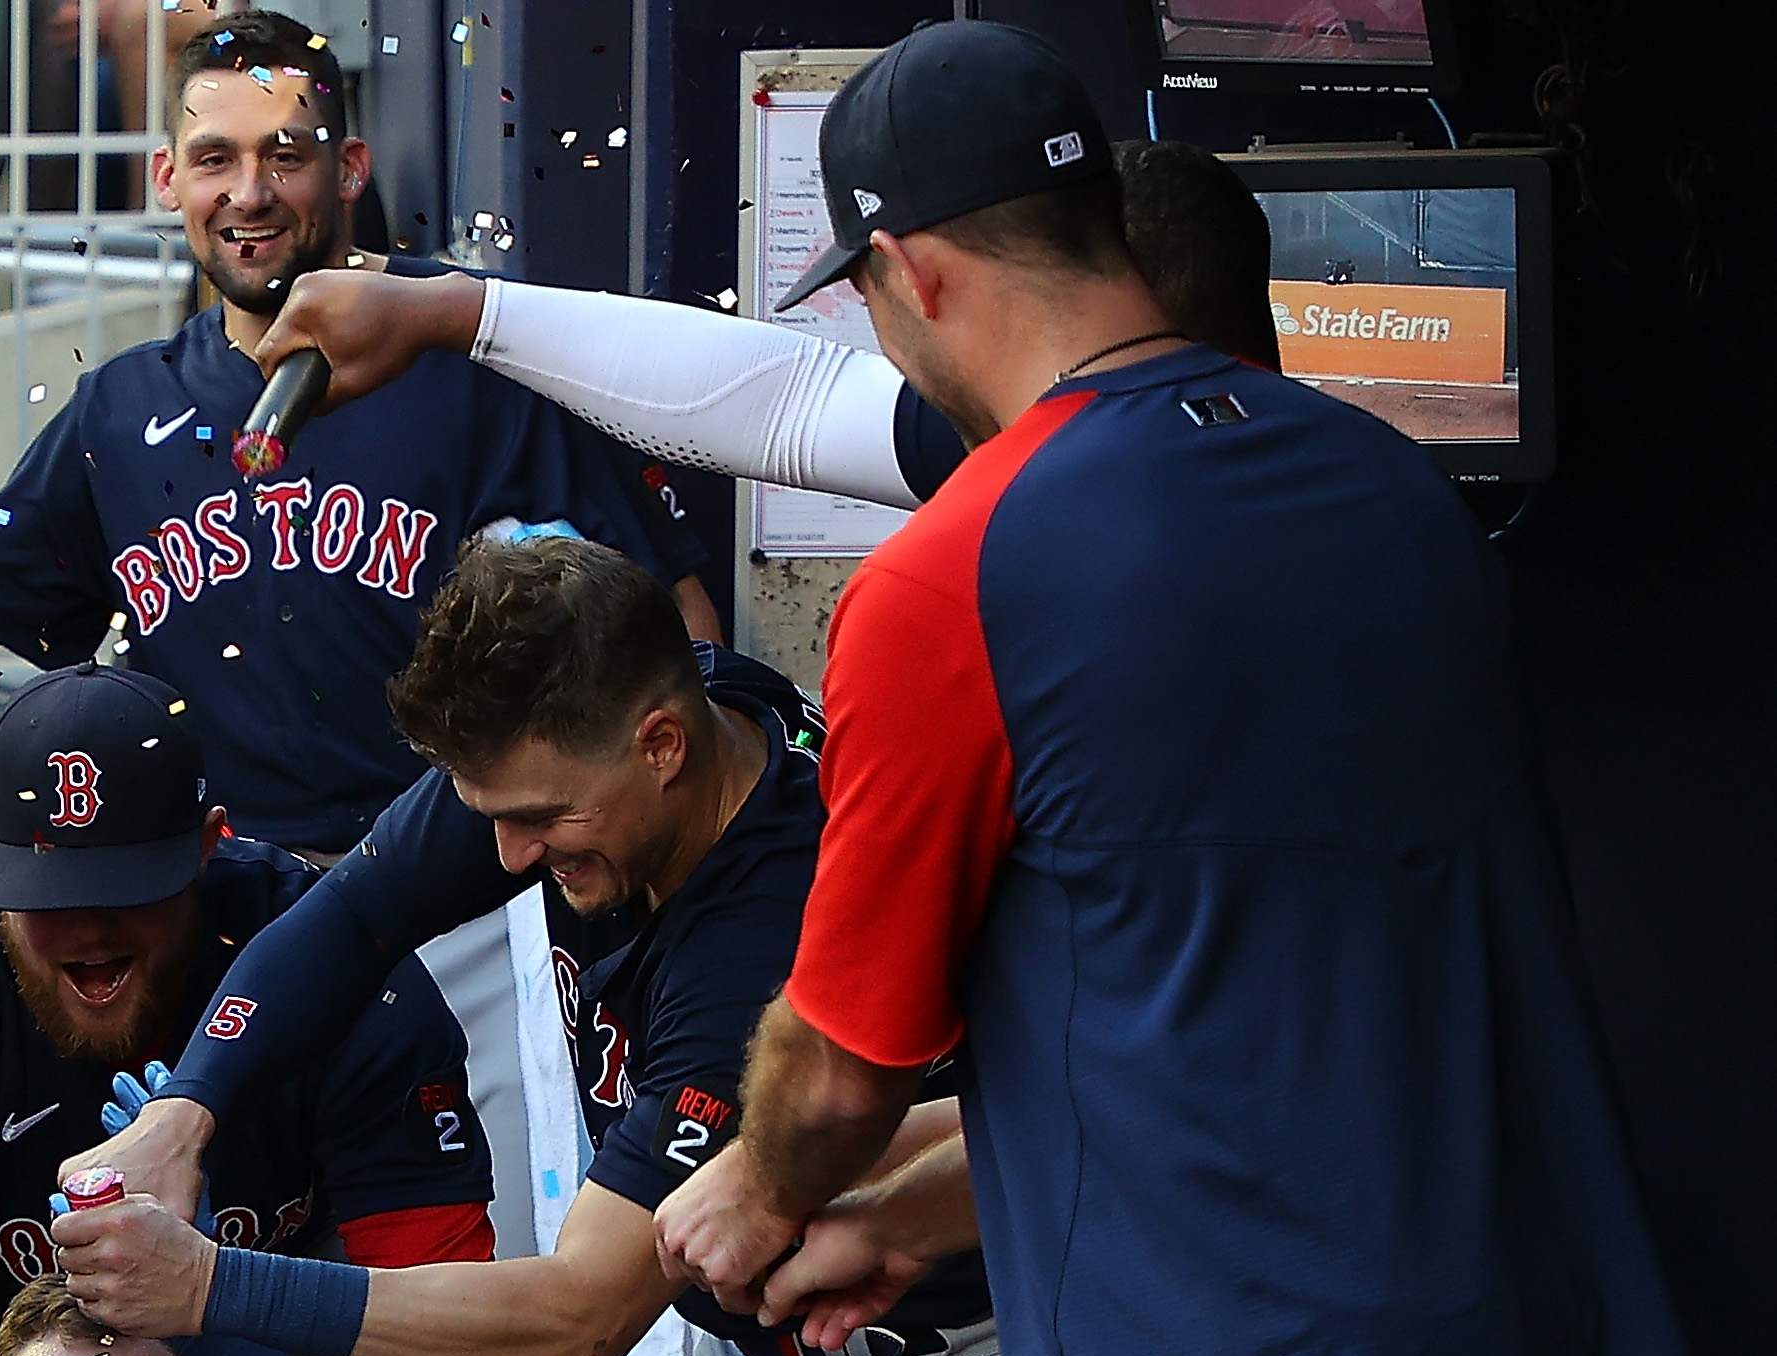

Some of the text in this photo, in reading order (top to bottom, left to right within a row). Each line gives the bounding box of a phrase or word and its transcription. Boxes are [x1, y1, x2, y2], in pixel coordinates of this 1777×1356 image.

[112, 477, 438, 636] BOSTON
[47, 751, 104, 827] B
[204, 995, 258, 1040] 5
[434, 1110, 466, 1152] 2
[675, 1086, 734, 1130] REMY
[665, 1119, 710, 1168] 2
